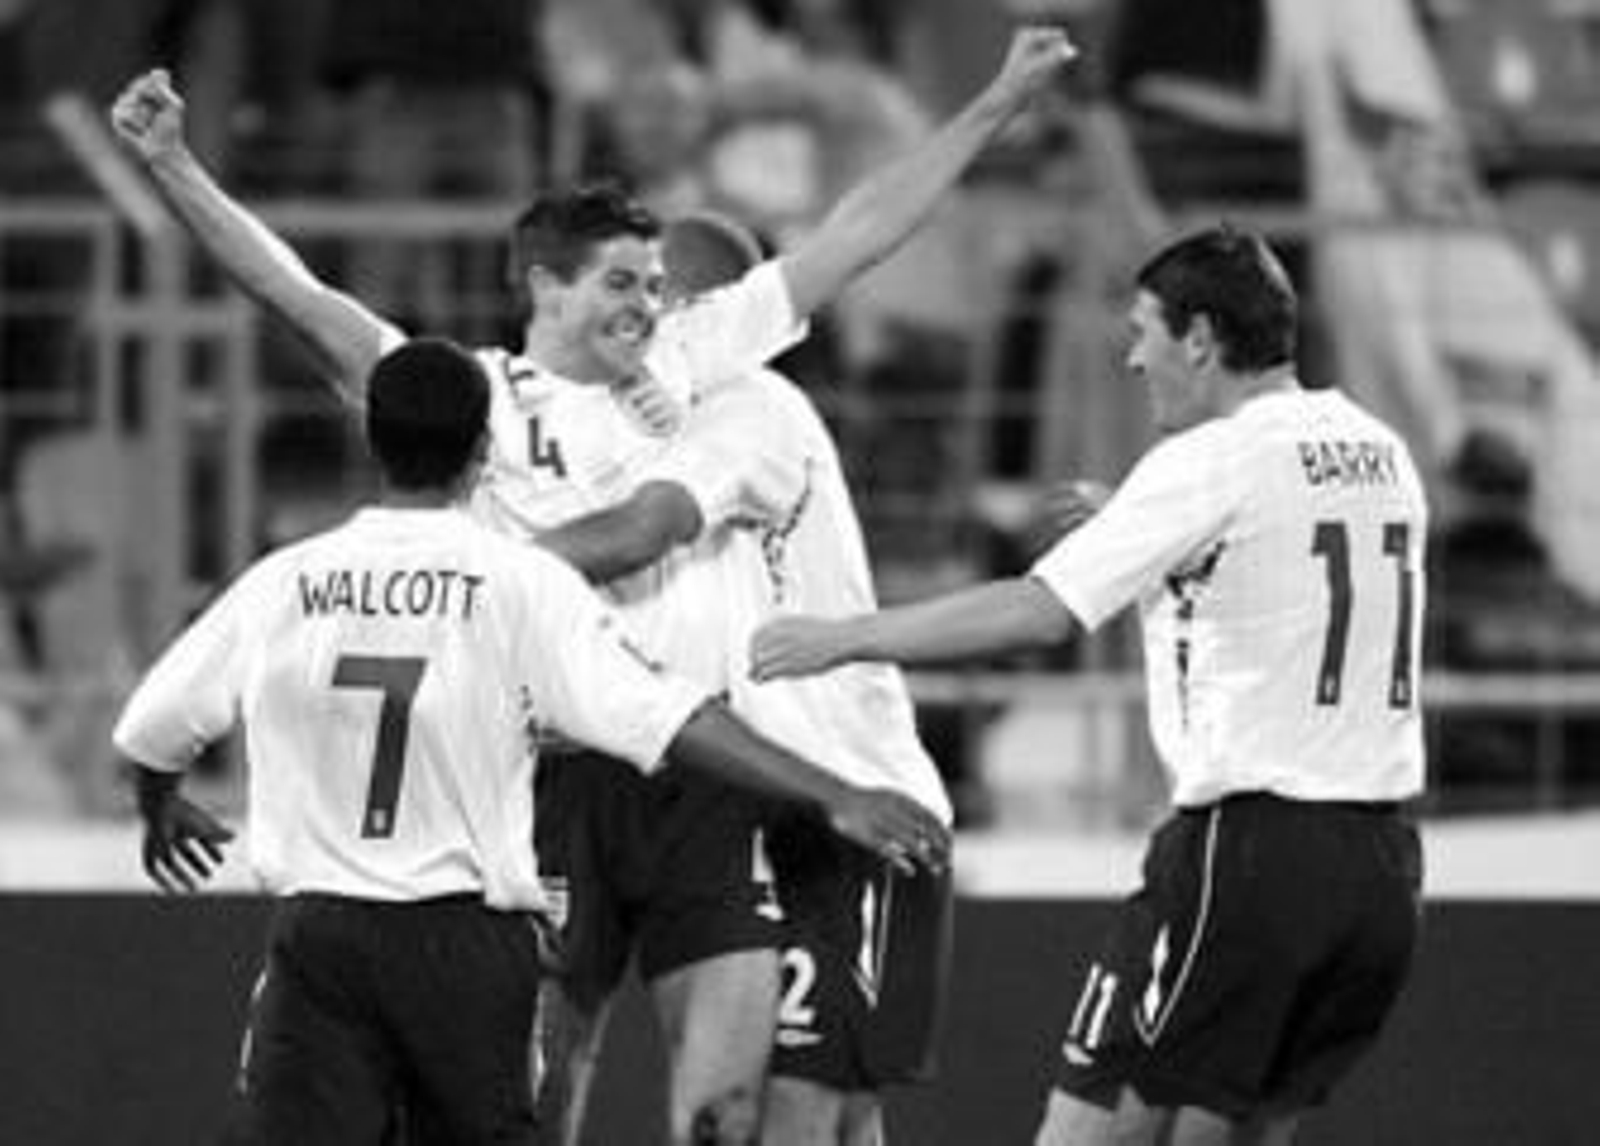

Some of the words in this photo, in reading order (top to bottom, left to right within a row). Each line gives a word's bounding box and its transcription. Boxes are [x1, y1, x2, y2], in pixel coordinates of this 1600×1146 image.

[528, 416, 566, 478] 4
[1298, 441, 1398, 486] BARRY
[298, 570, 485, 620] WALCOTT
[1311, 521, 1413, 709] 11
[332, 656, 428, 839] 7
[780, 947, 816, 1026] 2
